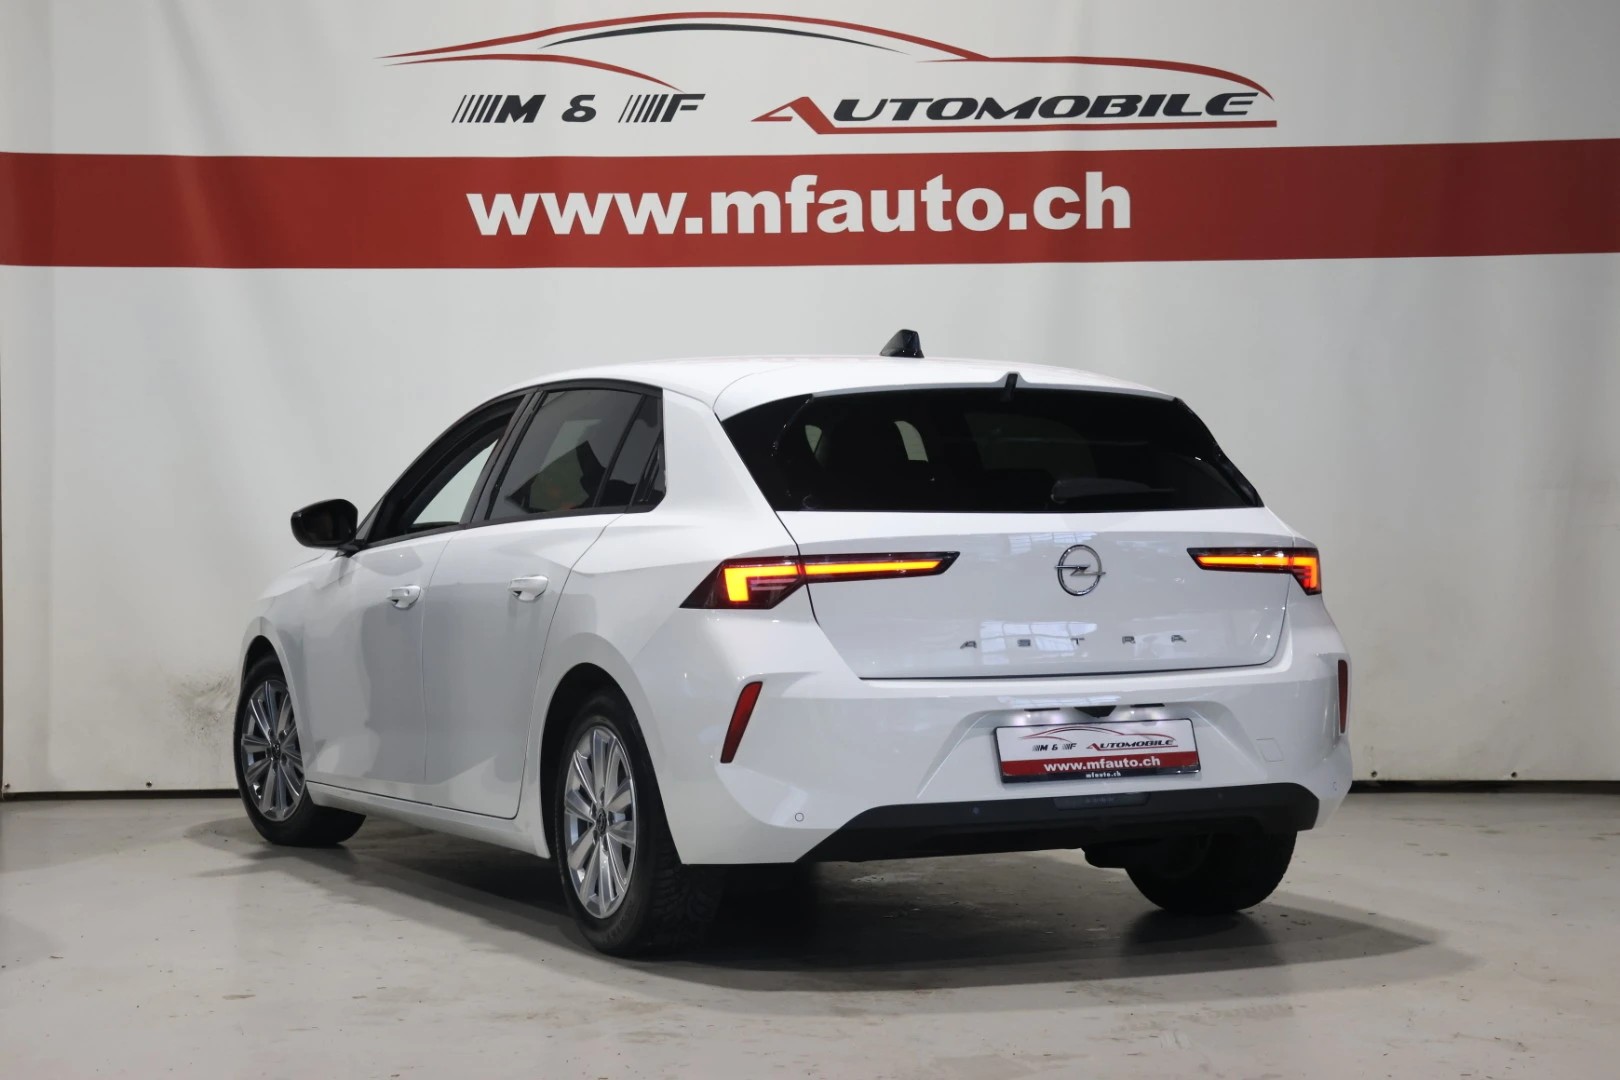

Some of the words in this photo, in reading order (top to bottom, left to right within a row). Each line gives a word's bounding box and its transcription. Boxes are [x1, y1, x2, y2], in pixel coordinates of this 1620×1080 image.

[494, 94, 546, 123] M
[561, 94, 597, 123] &
[659, 93, 706, 123] F
[751, 92, 1259, 134] AUTOMOBILE
[466, 171, 1131, 236] www.mfauto.ch
[959, 634, 1187, 650] ASTRA
[1086, 739, 1174, 752] AUTOMOBILE
[1043, 756, 1161, 772] www.mfauto.ch
